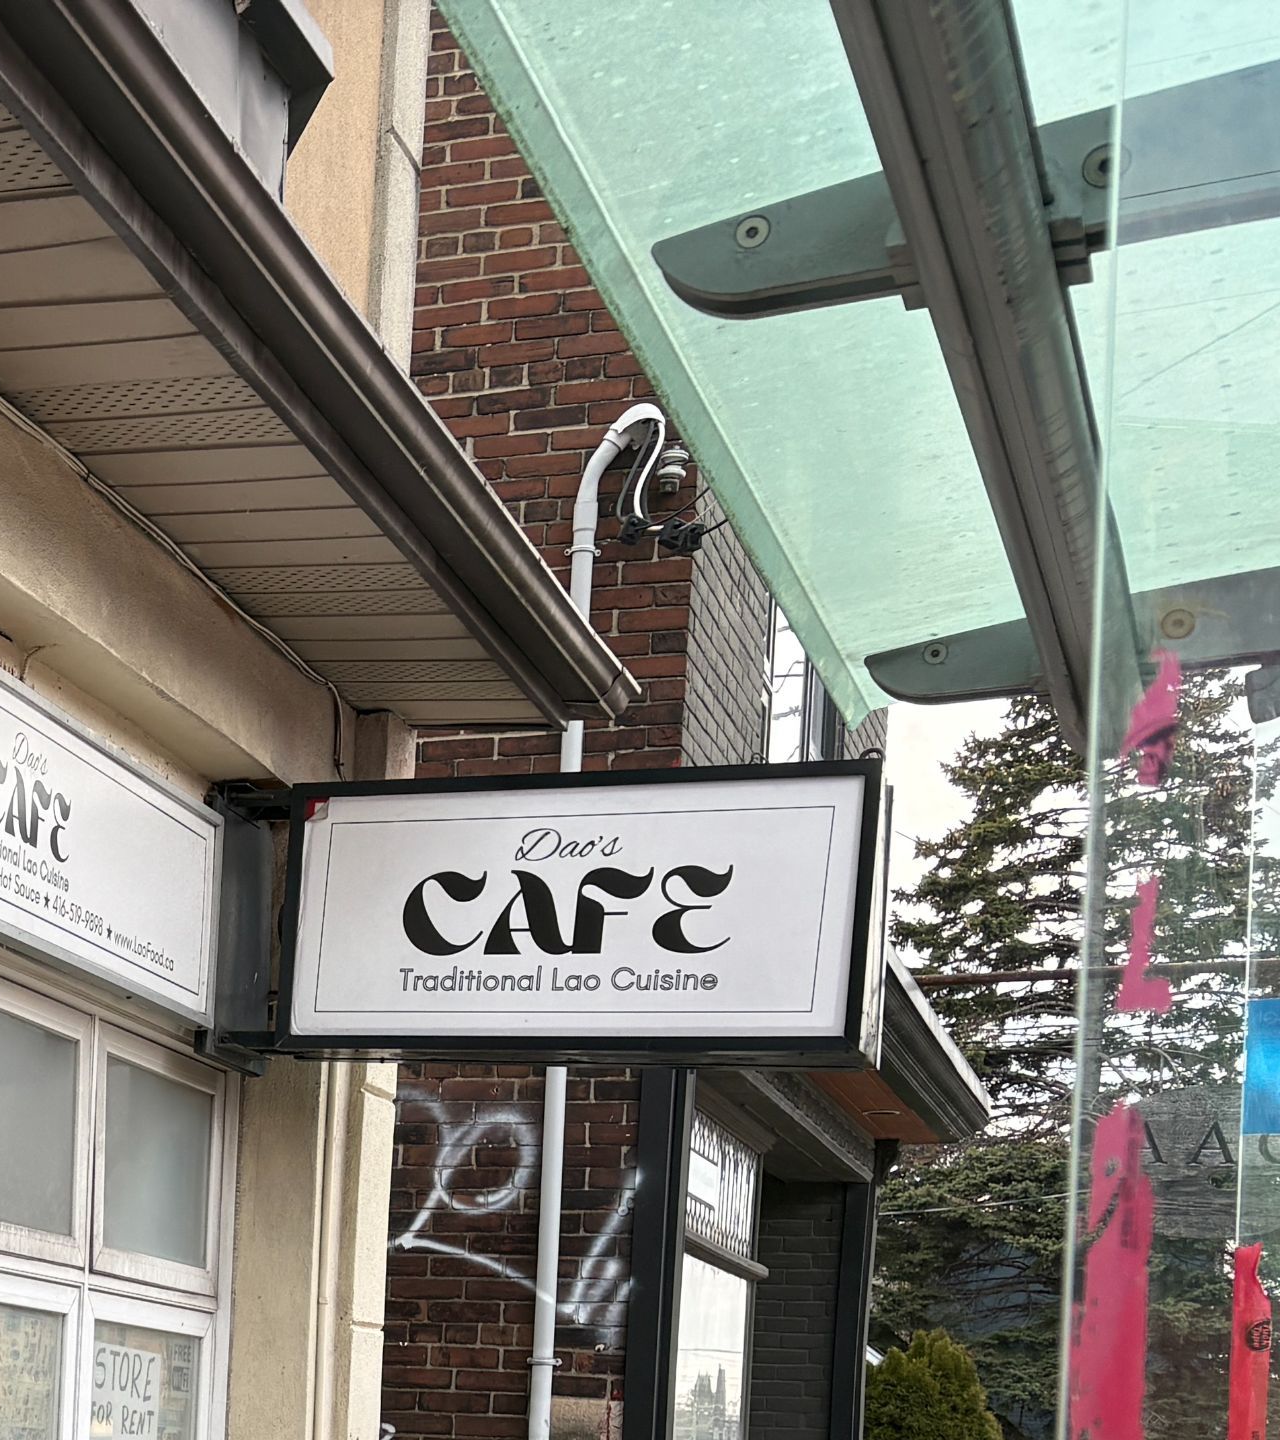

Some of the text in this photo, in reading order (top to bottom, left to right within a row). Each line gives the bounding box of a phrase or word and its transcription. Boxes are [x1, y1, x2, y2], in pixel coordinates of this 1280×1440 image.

[12, 732, 49, 775] Dao's
[515, 828, 623, 861] Dao's
[22, 849, 38, 876] Lao
[40, 859, 70, 892] Cuisine
[14, 874, 41, 904] Sauce
[52, 894, 104, 937] 416-519-9898
[403, 864, 734, 956] CAFE
[399, 965, 719, 992] Traditional Lao Cuisine
[94, 1347, 156, 1402] STORE
[91, 1401, 154, 1436] FOR RENT
